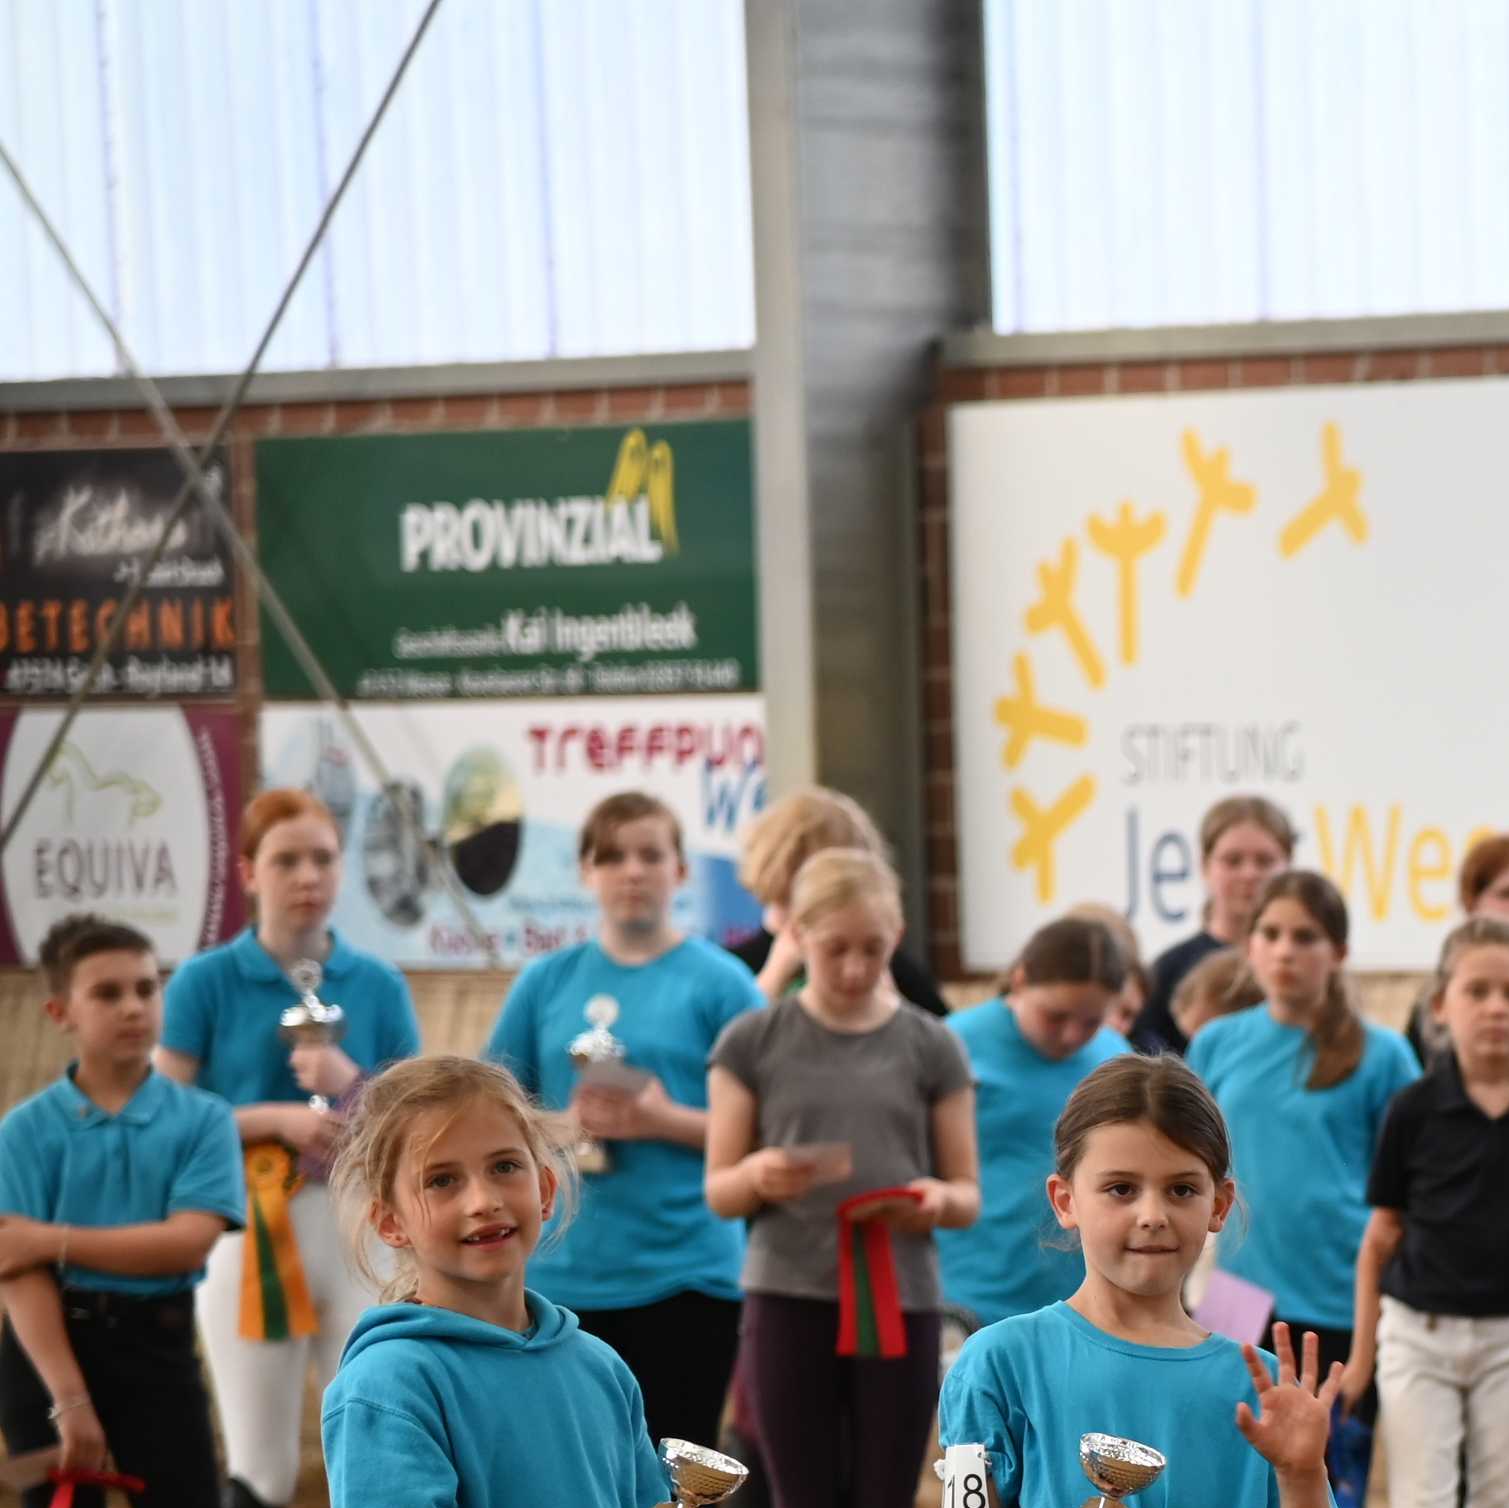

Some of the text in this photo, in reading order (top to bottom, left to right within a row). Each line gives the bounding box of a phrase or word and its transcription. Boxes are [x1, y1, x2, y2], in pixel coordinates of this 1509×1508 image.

[400, 494, 664, 573] PROVINZIAL
[1119, 721, 1304, 789] STIFTUNG
[35, 838, 177, 901] EQUIVA
